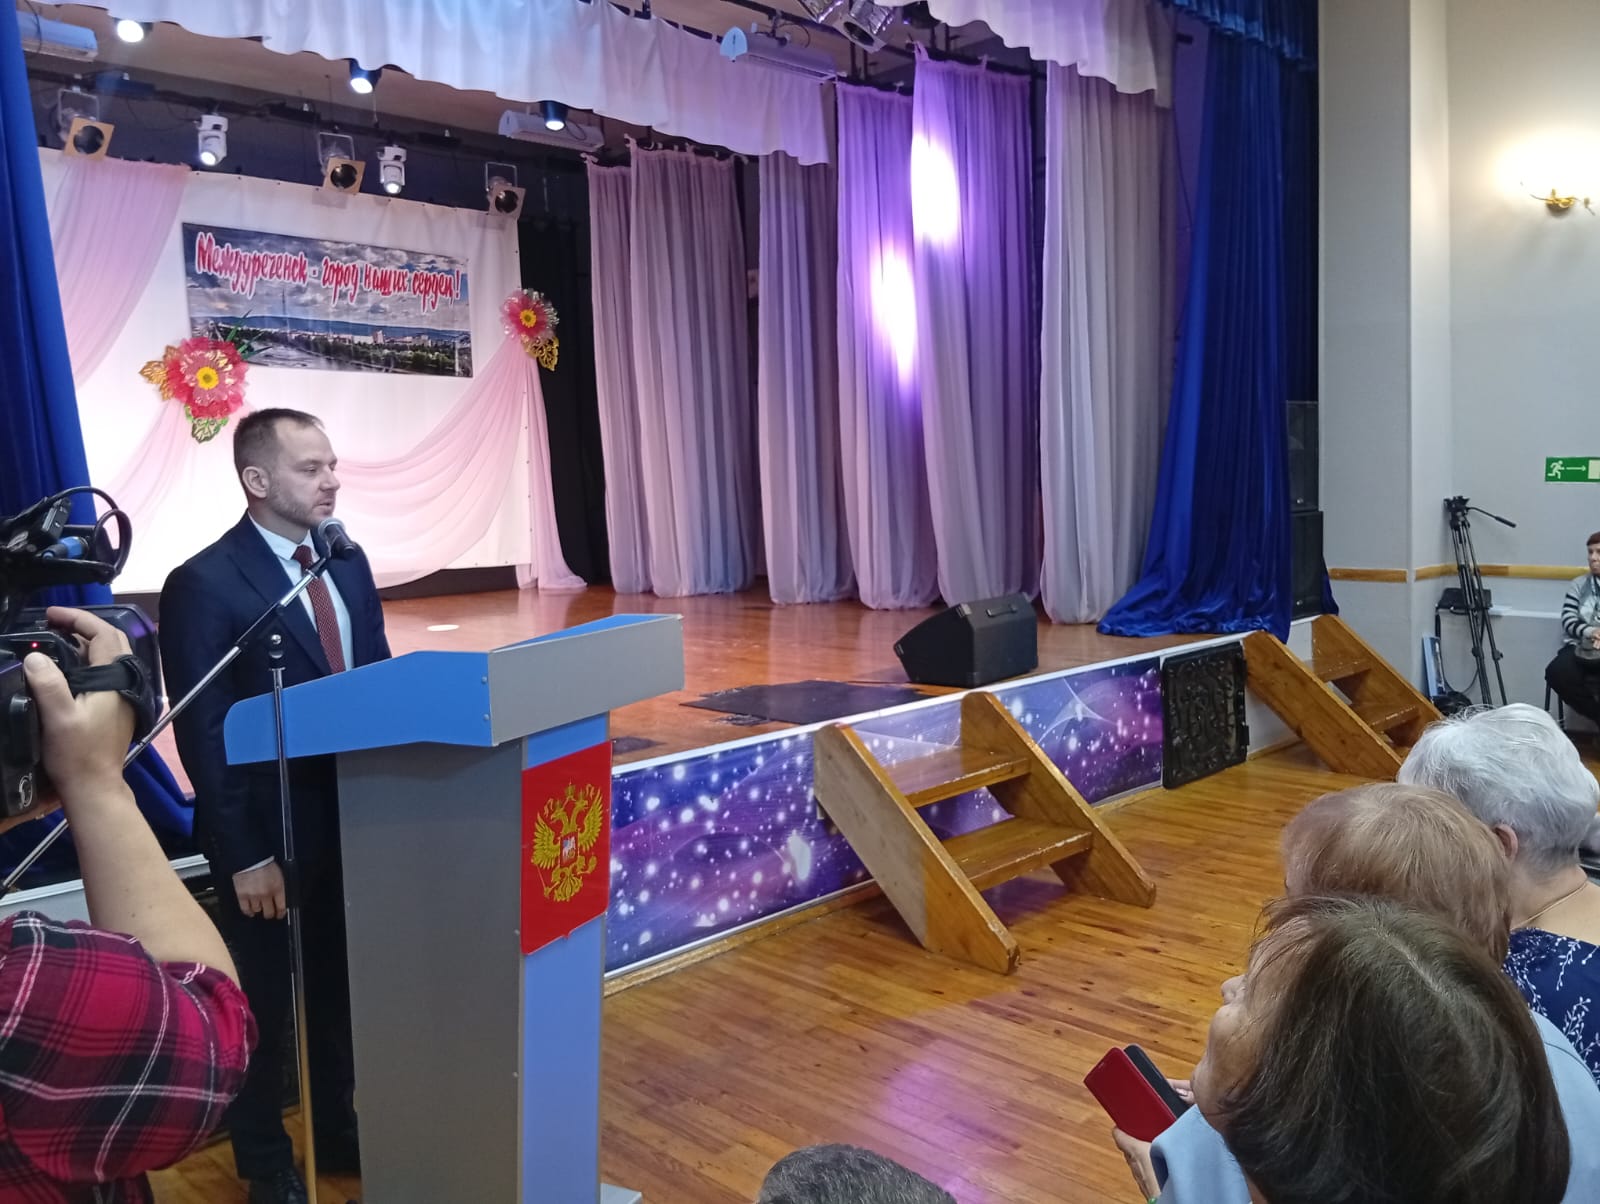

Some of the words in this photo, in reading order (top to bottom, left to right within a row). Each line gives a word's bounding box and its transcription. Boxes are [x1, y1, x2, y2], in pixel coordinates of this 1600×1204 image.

[197, 232, 307, 298] Междуреченск
[322, 257, 359, 305] город
[363, 263, 409, 296] наших
[412, 269, 460, 312] сердец!
